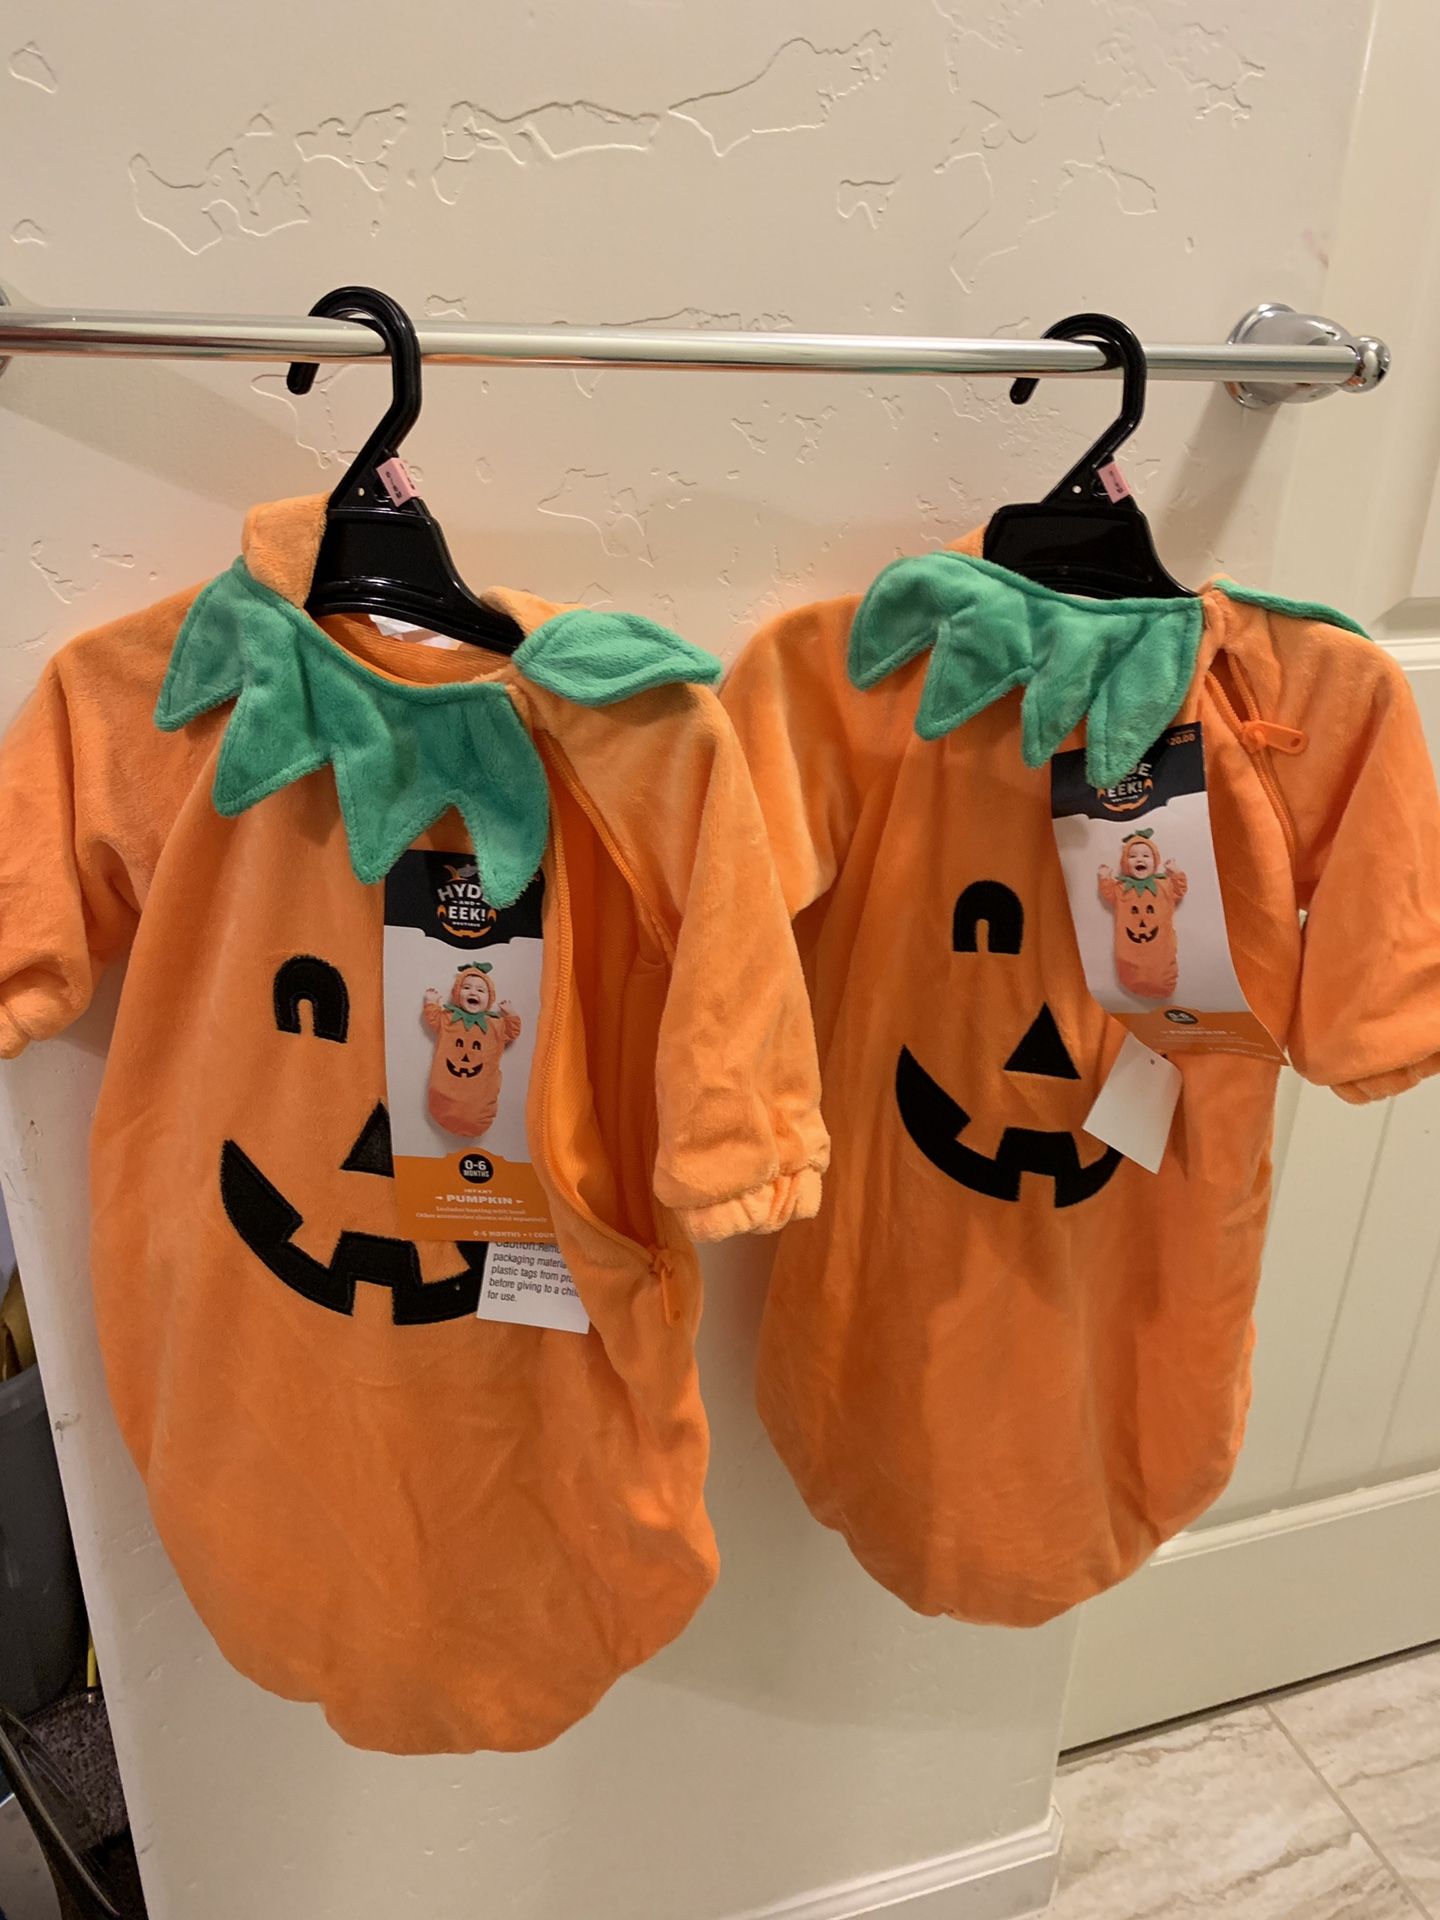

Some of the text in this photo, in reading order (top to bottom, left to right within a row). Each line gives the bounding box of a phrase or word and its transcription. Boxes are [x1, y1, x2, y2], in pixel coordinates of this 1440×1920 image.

[1107, 780, 1143, 798] EEK!
[437, 883, 484, 902] HYD
[448, 905, 486, 922] EEK!
[464, 1159, 487, 1171] 0-6
[463, 1169, 490, 1178] MONTHS
[446, 1194, 513, 1205] PUMPKIN
[493, 1253, 535, 1266] packaging
[491, 1265, 574, 1283] plastic tags from pro
[489, 1277, 515, 1289] before
[517, 1280, 542, 1294] giving
[544, 1284, 552, 1293] to
[553, 1286, 560, 1295] a
[487, 1290, 517, 1303] for use.
